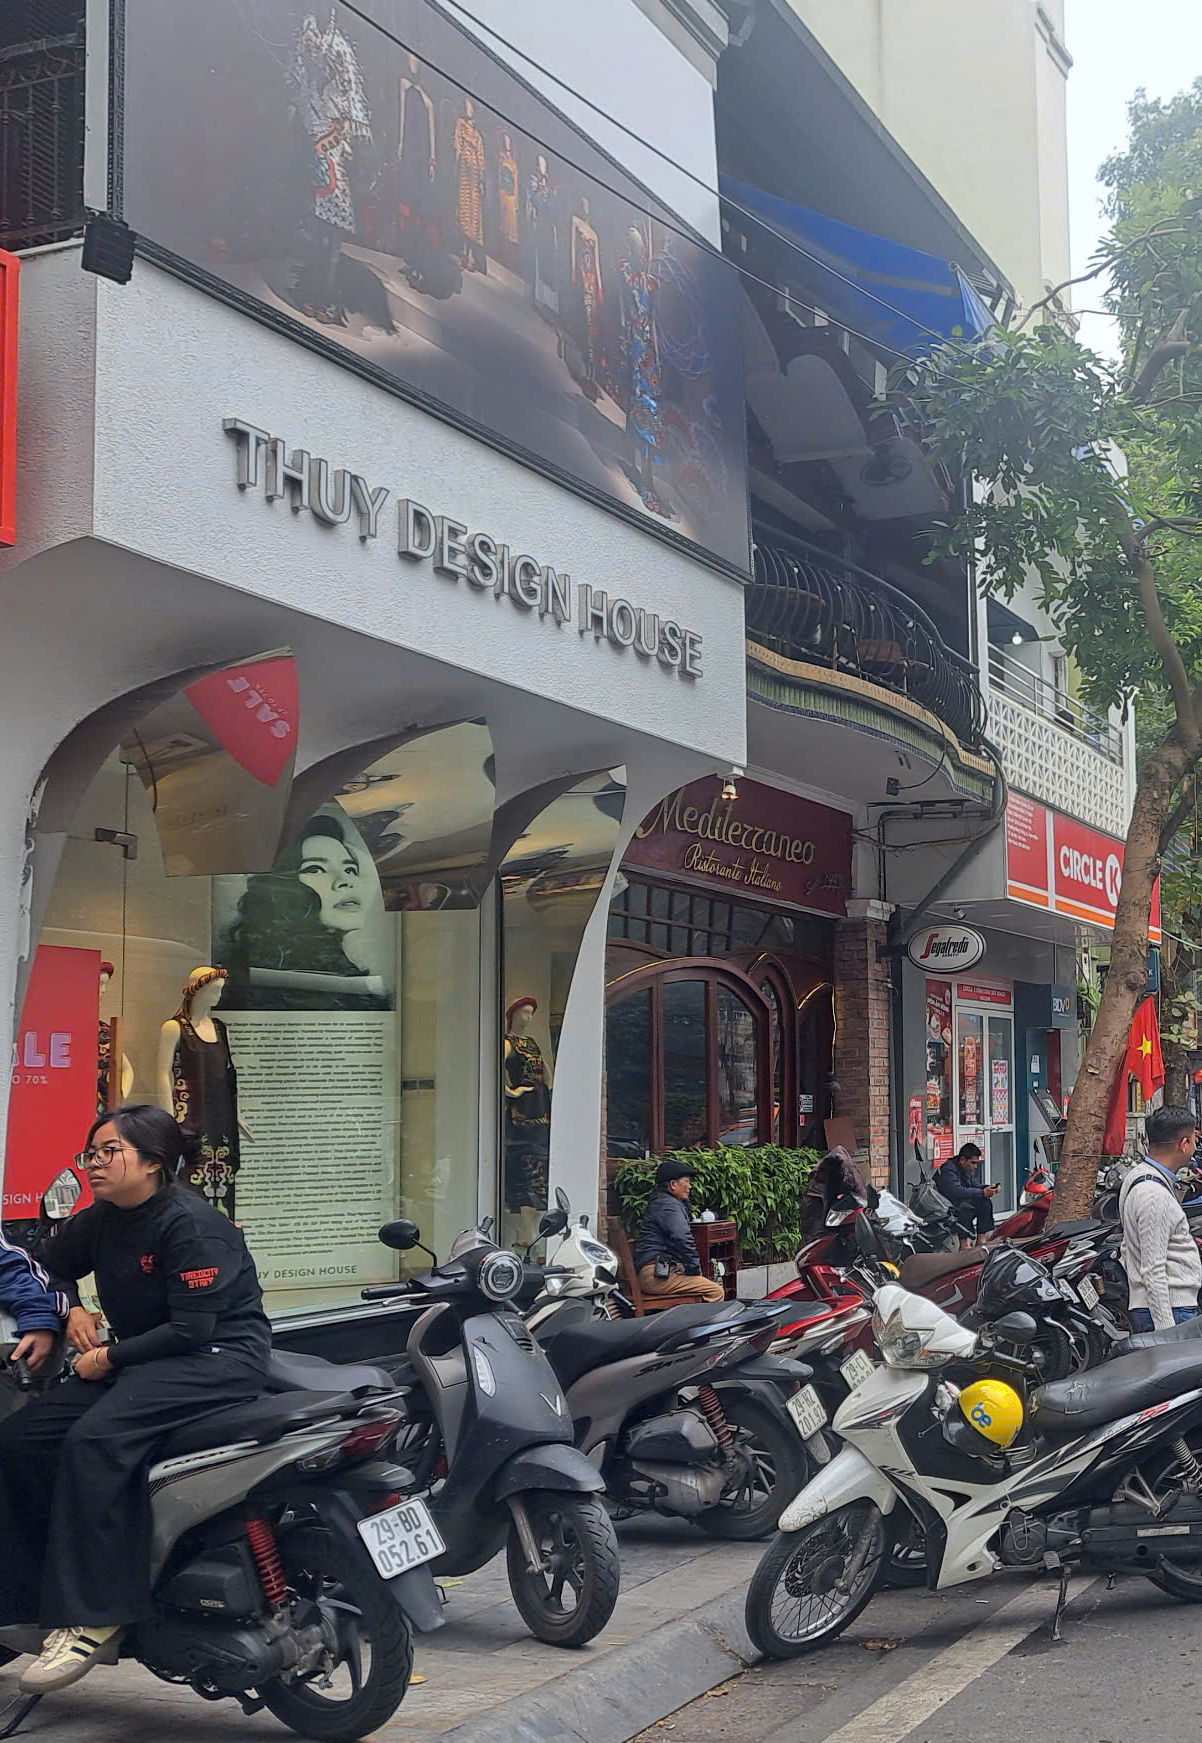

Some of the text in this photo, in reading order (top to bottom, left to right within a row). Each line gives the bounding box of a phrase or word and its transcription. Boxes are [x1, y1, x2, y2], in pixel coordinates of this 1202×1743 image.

[222, 417, 704, 680] THUY DESIGN HOUSE
[636, 786, 816, 865] Mediterraneo
[684, 842, 746, 882] Ristorante
[1060, 845, 1103, 890] CIRCLE
[274, 1268, 315, 1279] DESIGN
[319, 1265, 357, 1275] HOUSE
[370, 1506, 422, 1546] 29-BD
[378, 1528, 439, 1573] 052.61
